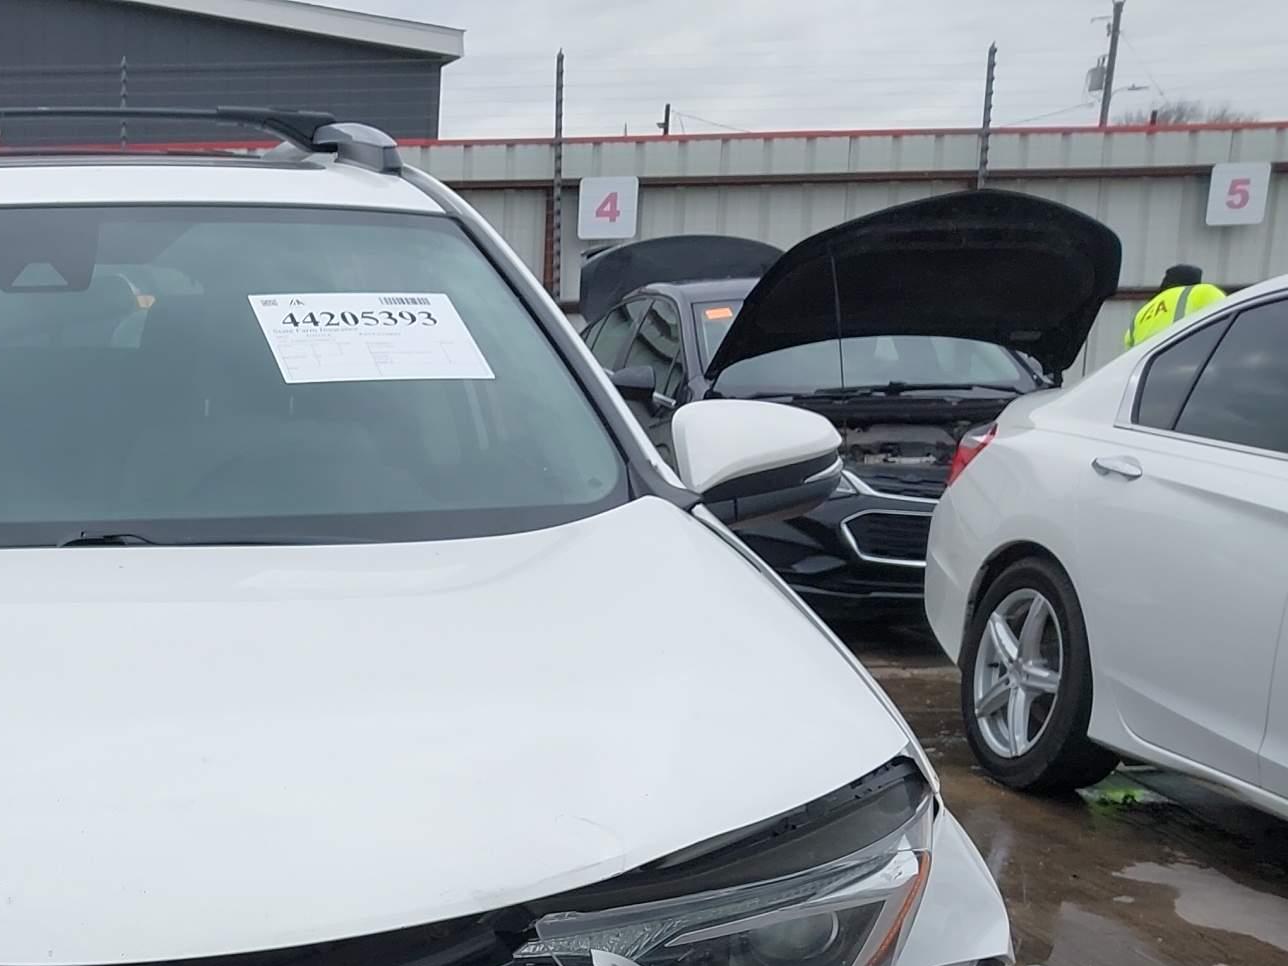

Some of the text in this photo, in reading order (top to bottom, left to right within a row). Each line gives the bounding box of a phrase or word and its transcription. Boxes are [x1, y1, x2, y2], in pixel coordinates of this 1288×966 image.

[595, 192, 621, 222] 4
[1225, 178, 1251, 209] 5
[281, 310, 438, 327] 44205393
